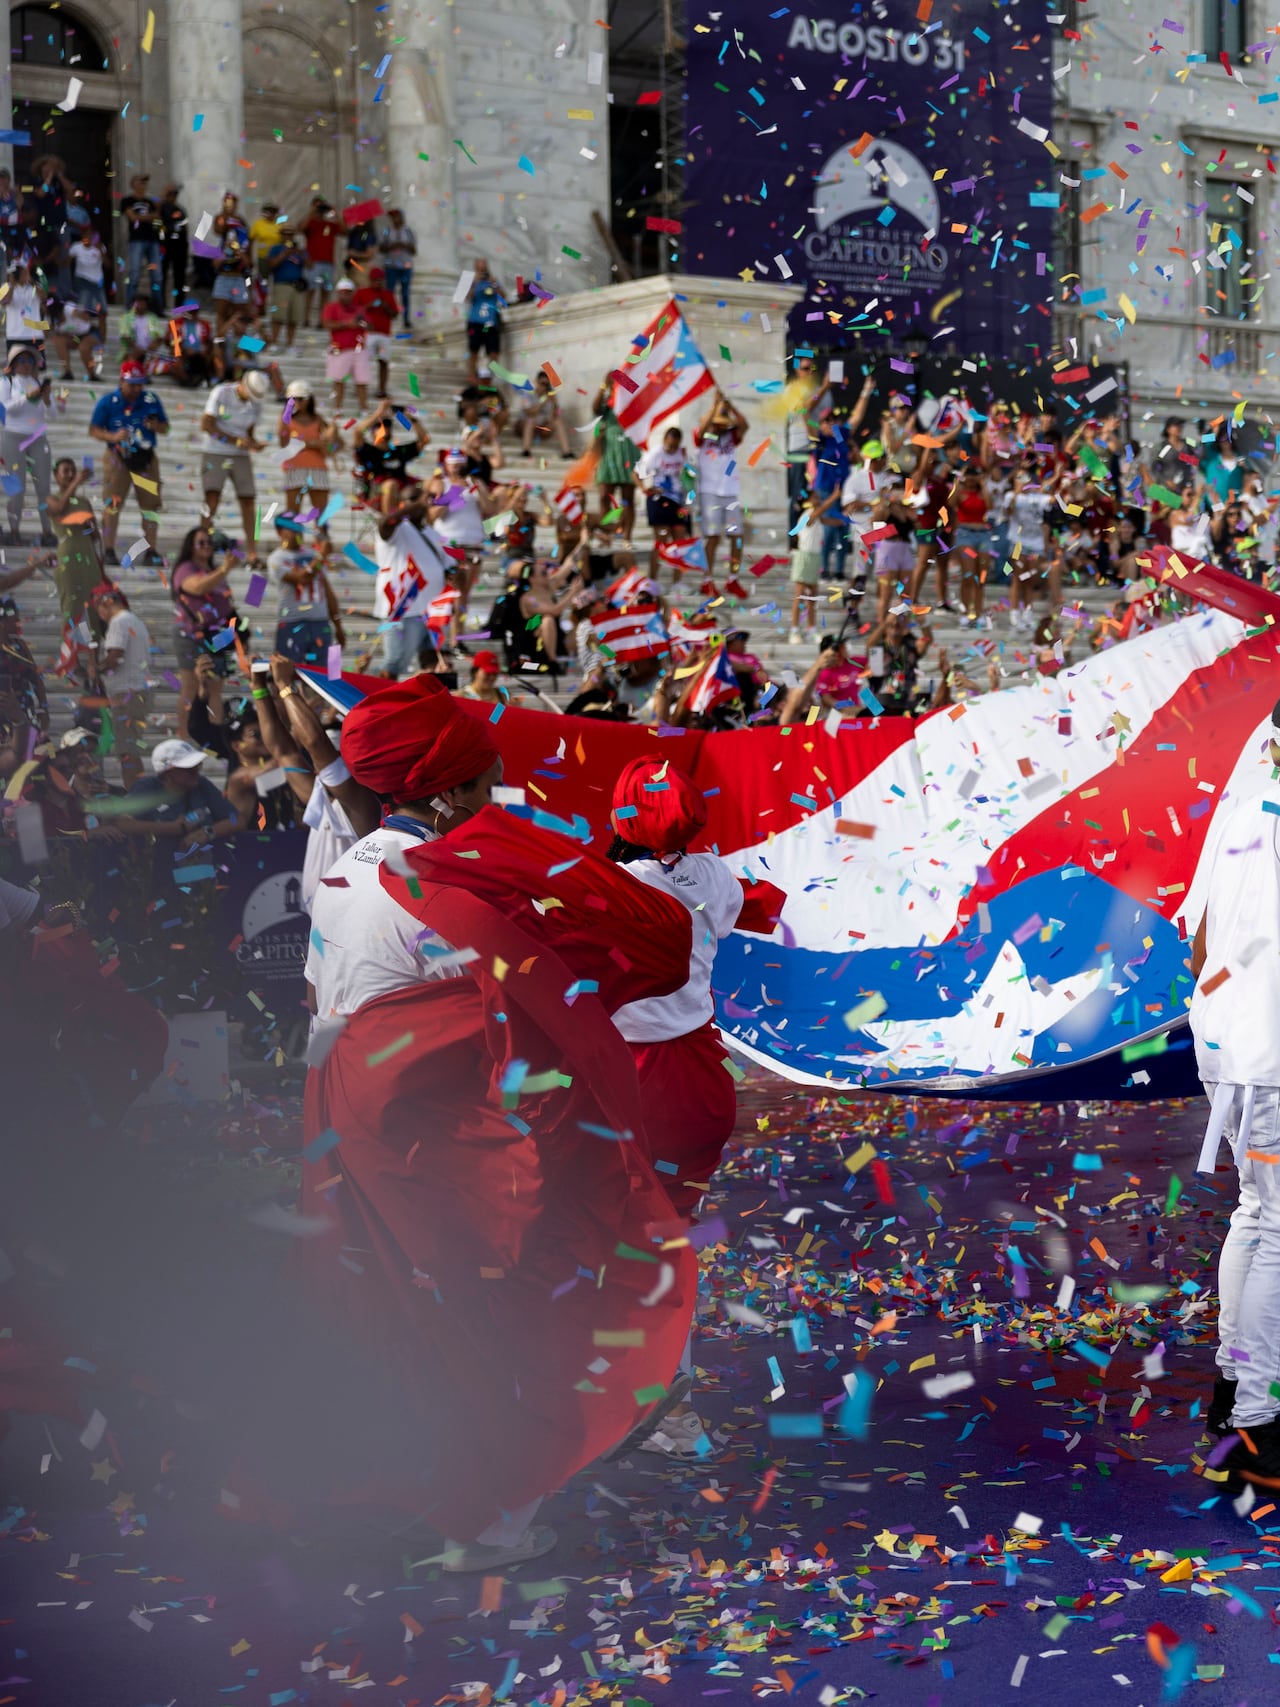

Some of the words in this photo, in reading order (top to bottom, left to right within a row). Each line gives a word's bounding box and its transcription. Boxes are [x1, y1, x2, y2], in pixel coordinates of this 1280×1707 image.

[788, 15, 930, 66] AGOSTO
[934, 37, 966, 72] 31
[362, 841, 383, 854] Taller
